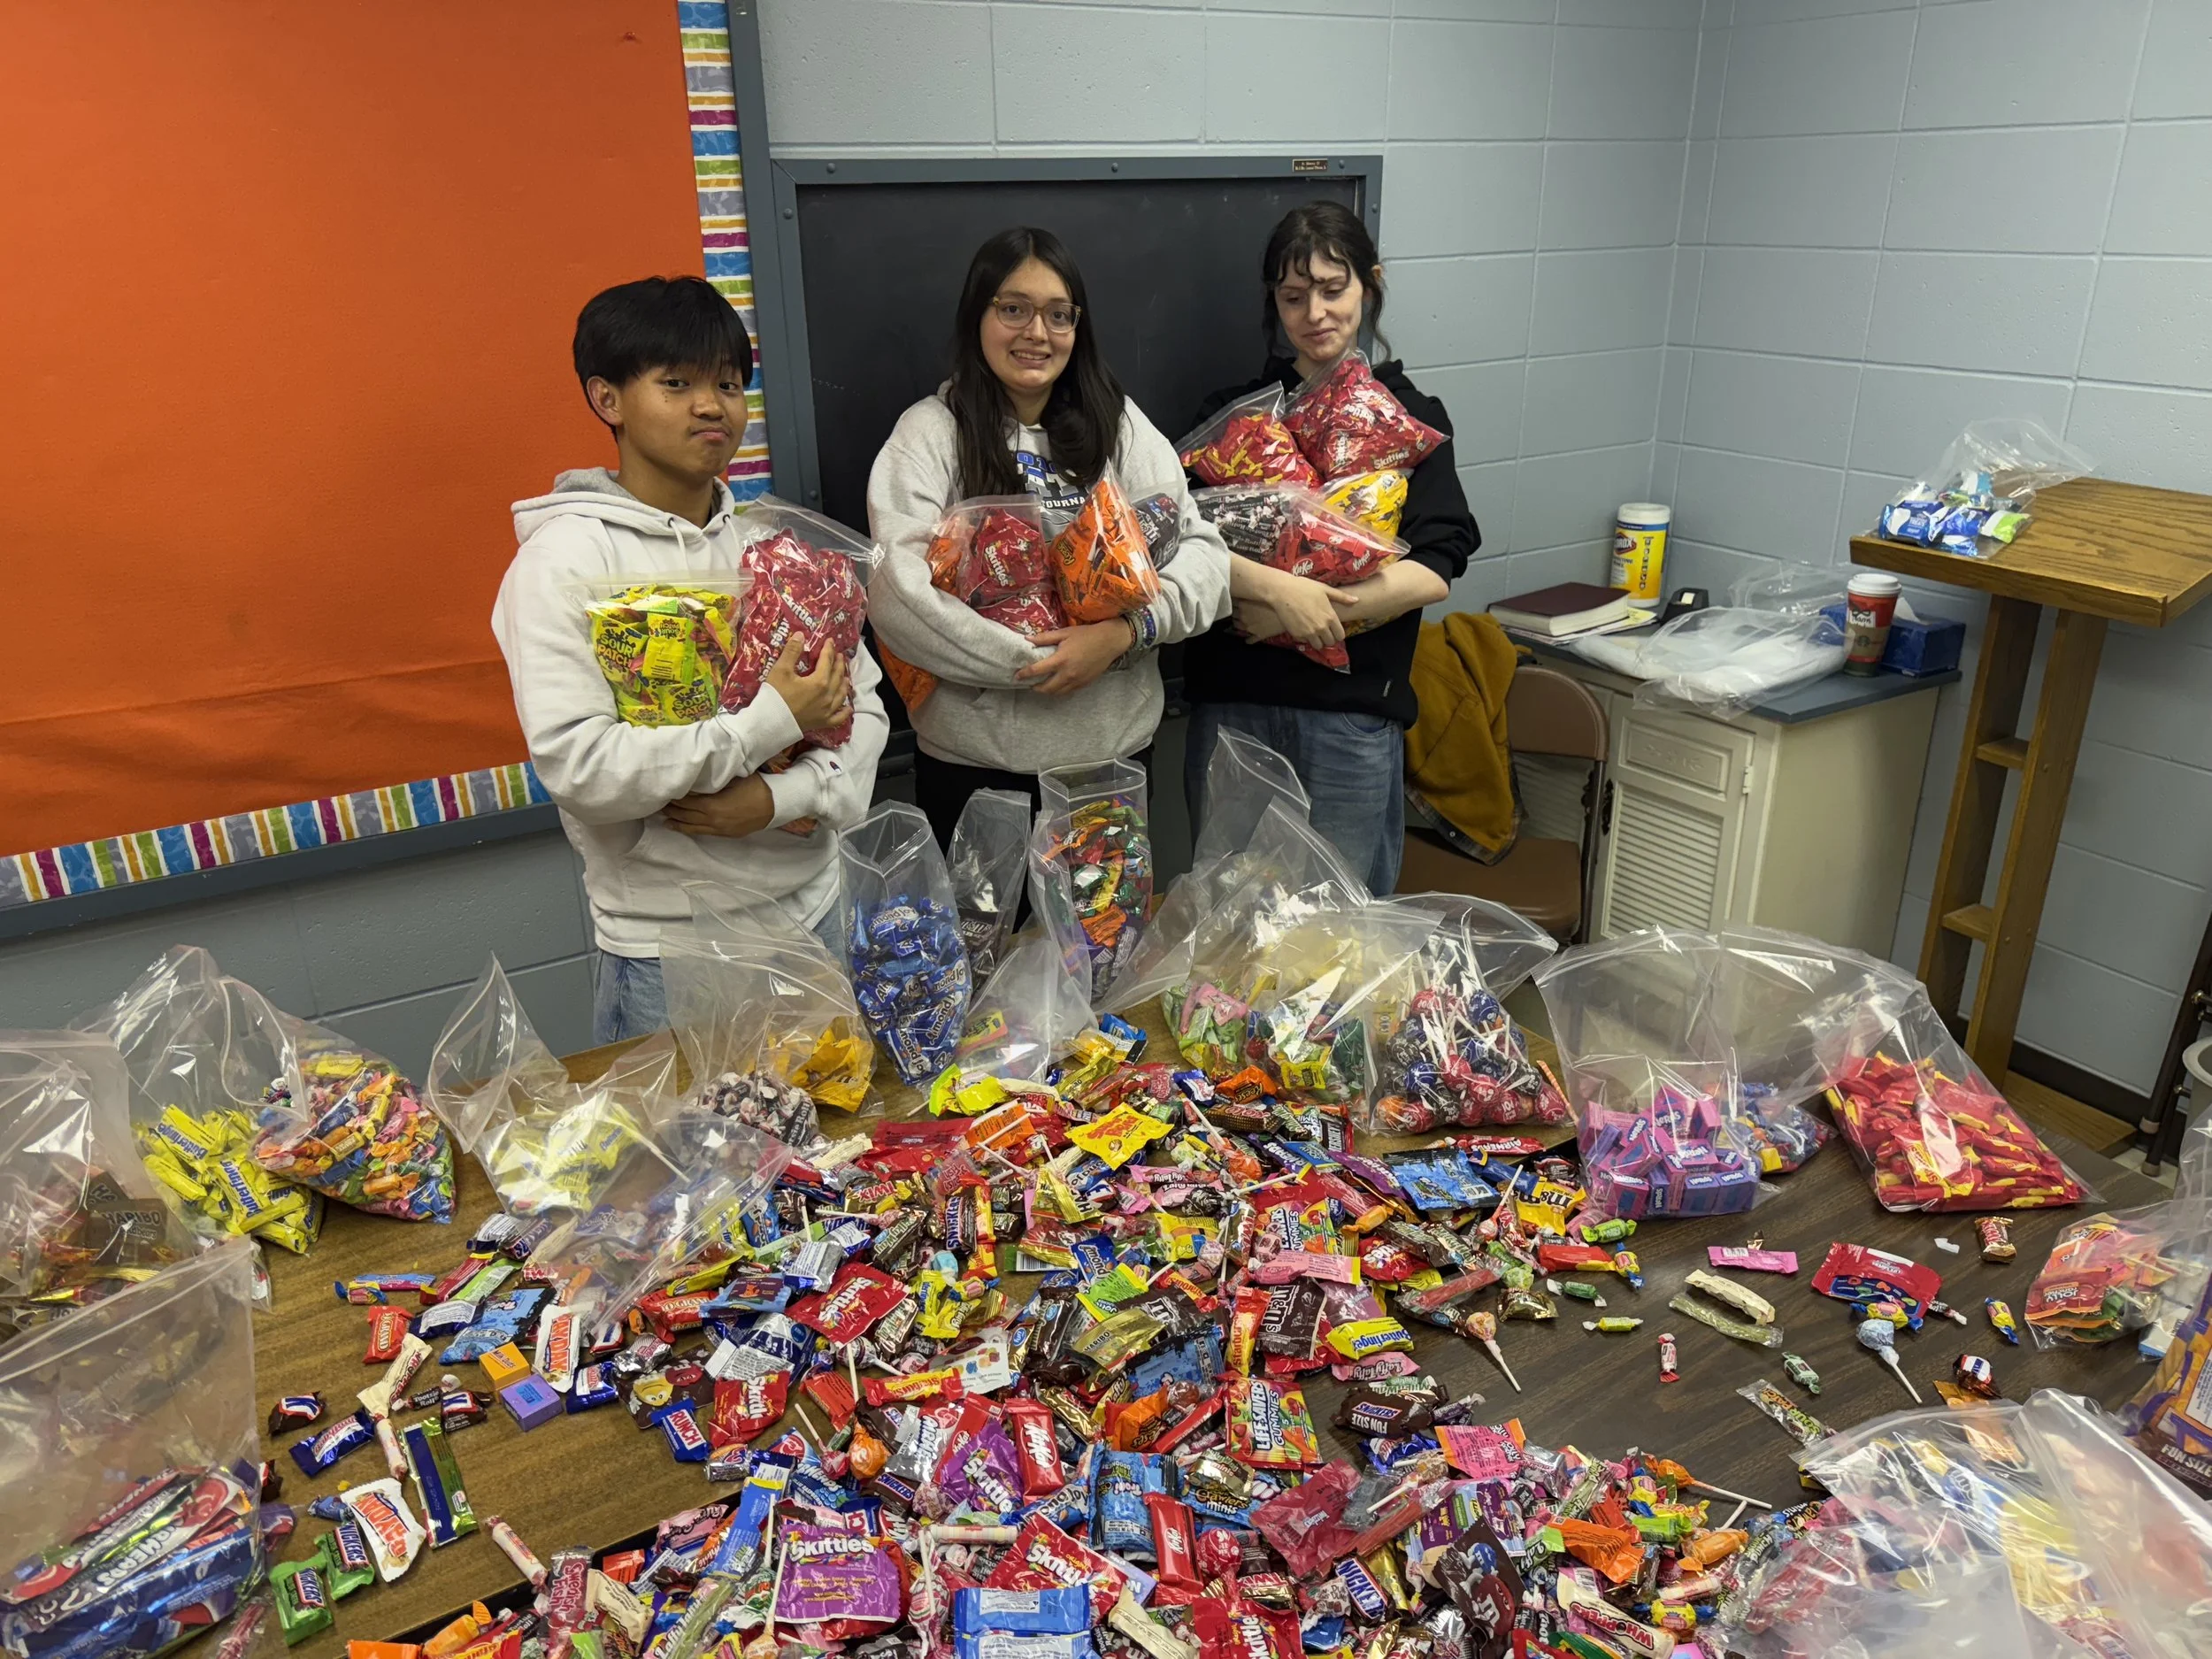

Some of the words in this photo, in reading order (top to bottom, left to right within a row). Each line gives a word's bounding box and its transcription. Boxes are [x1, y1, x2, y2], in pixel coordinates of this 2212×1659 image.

[1373, 449, 1409, 471] Skittles
[1041, 495, 1086, 509] TOURNA
[984, 545, 1010, 588] Skittles
[599, 636, 634, 656] SOUR
[157, 1123, 208, 1159] Butterfinge
[220, 1159, 261, 1217] Butterfinge
[102, 1210, 160, 1229] HARIBO
[1288, 1210, 1301, 1251] UMMIES
[819, 1277, 872, 1322] Skittles
[2046, 1291, 2078, 1303] JOLLY
[1083, 1332, 1110, 1352] HARIBO
[390, 1351, 422, 1402] WHOPPERS
[1353, 1365, 1377, 1380] Taffy
[1376, 1362, 1402, 1378] Laffy
[414, 1390, 439, 1403] Tootsie
[746, 1376, 766, 1420] Skittl
[1271, 1390, 1285, 1447] GUMMIES
[1351, 1414, 1369, 1428] SIZE
[1356, 1403, 1400, 1417] SNICKERS
[670, 1409, 701, 1445] RUNCH
[1370, 1417, 1389, 1435] FUN
[1024, 1422, 1053, 1469] KitKat
[2161, 1444, 2185, 1463] FUN
[879, 1474, 915, 1500] SNICKERS
[963, 1460, 1015, 1514] Skittle
[1206, 1500, 1238, 1515] minis
[790, 1538, 875, 1562] Skittles
[549, 1579, 565, 1607] Fish
[564, 1563, 585, 1614] Swedish
[1242, 1614, 1269, 1659] kittle
[1569, 1602, 1654, 1649] WHOPPERS
